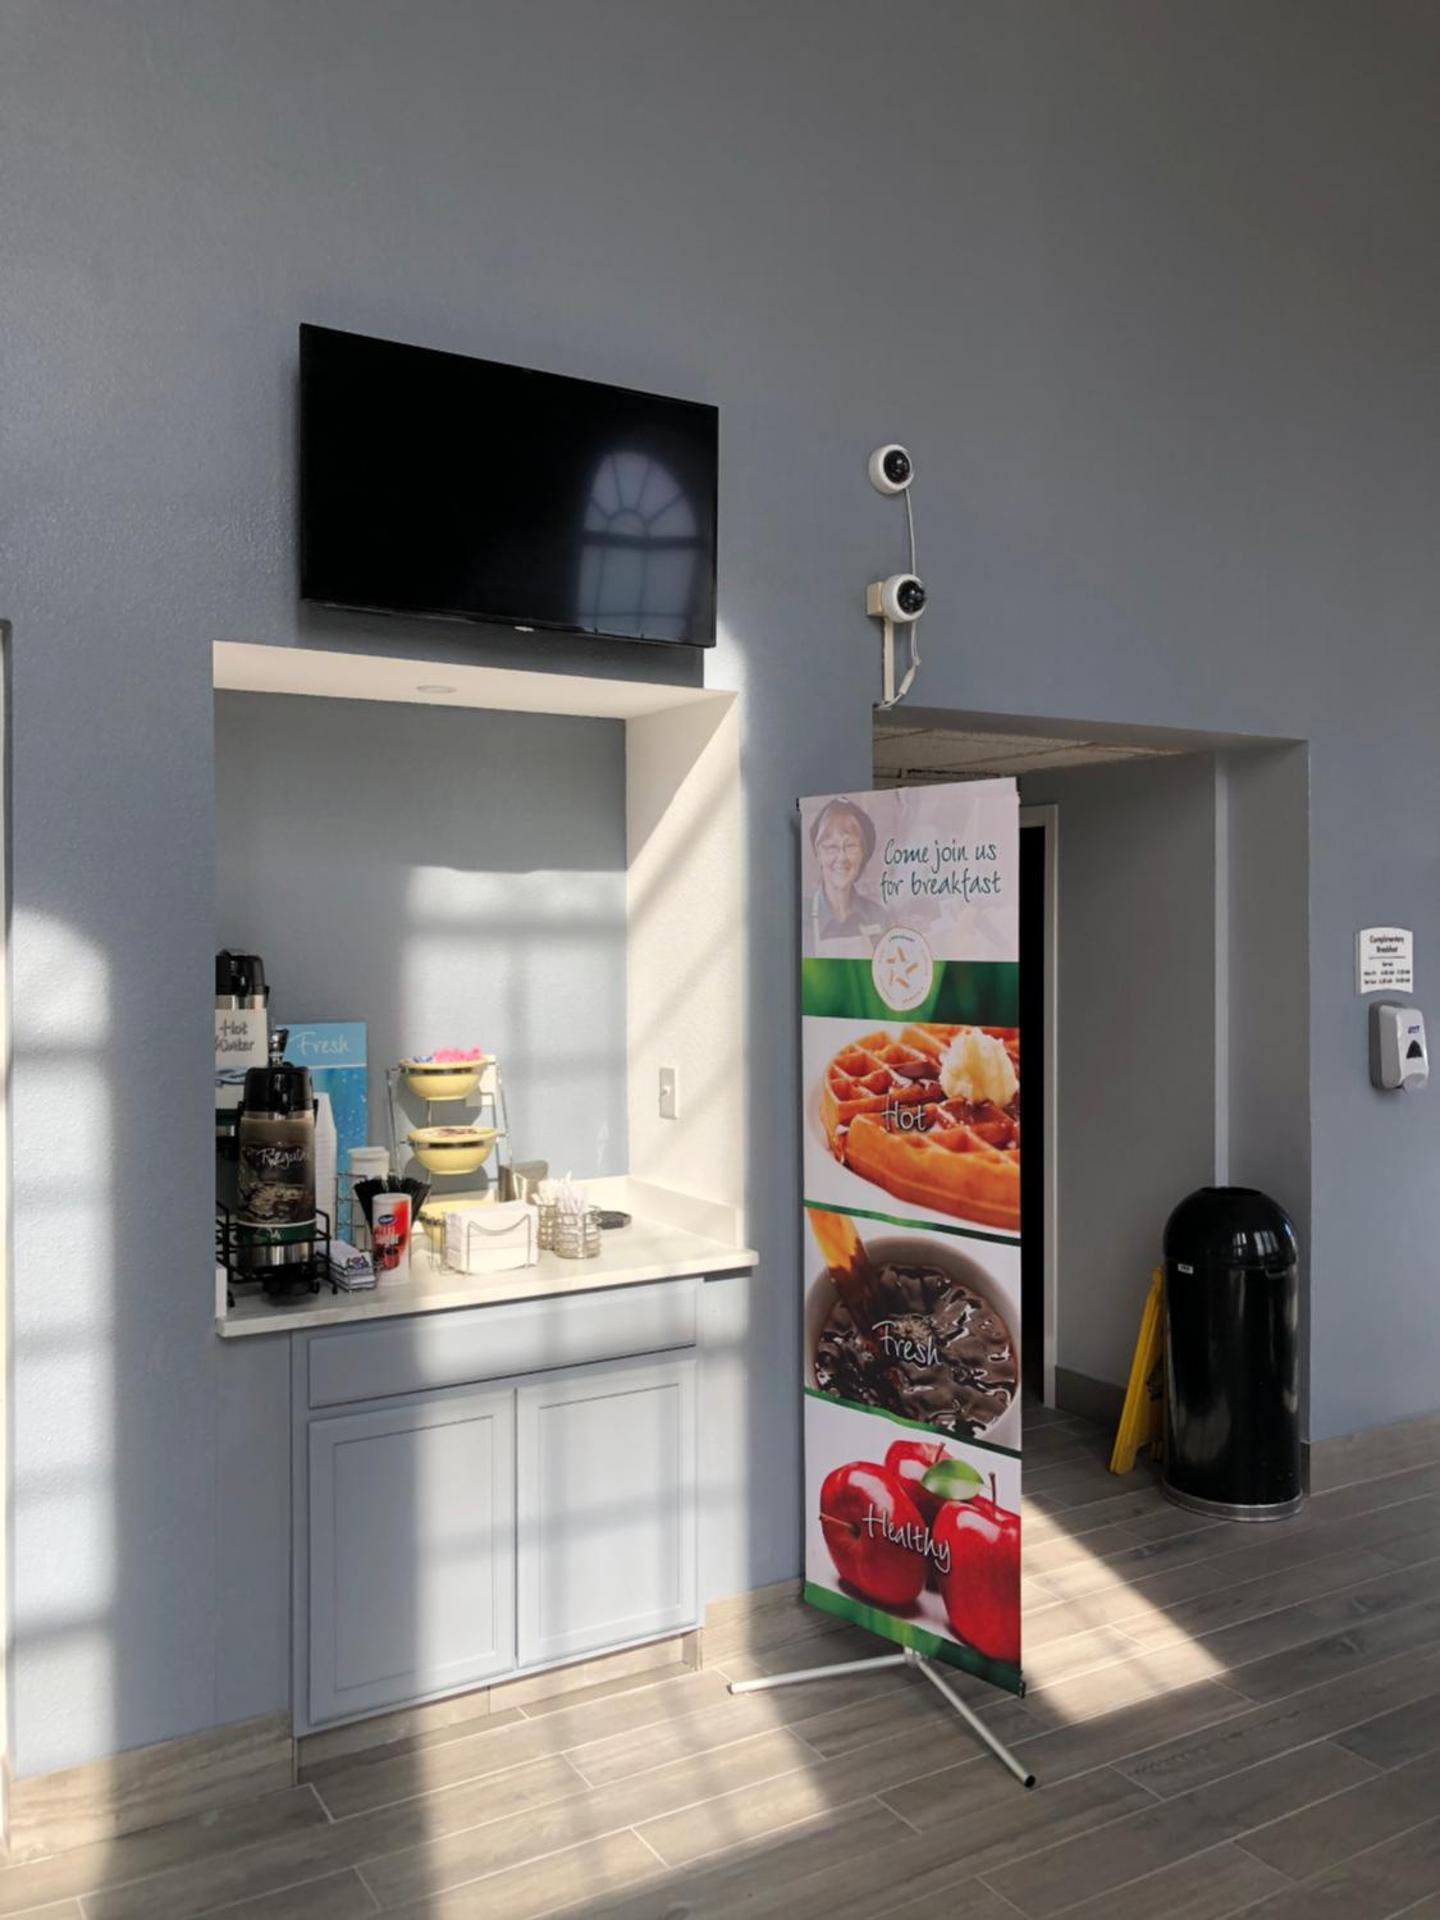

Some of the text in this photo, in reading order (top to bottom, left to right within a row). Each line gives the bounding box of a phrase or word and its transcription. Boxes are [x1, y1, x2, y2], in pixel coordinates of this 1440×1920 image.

[884, 839, 998, 874] Come join us
[880, 868, 1002, 905] for breakfast
[219, 1019, 249, 1037] Hot
[290, 1031, 350, 1055] Fresh
[880, 1094, 928, 1132] Hot
[871, 1320, 944, 1367] Fresh
[861, 1502, 951, 1574] Healthy
